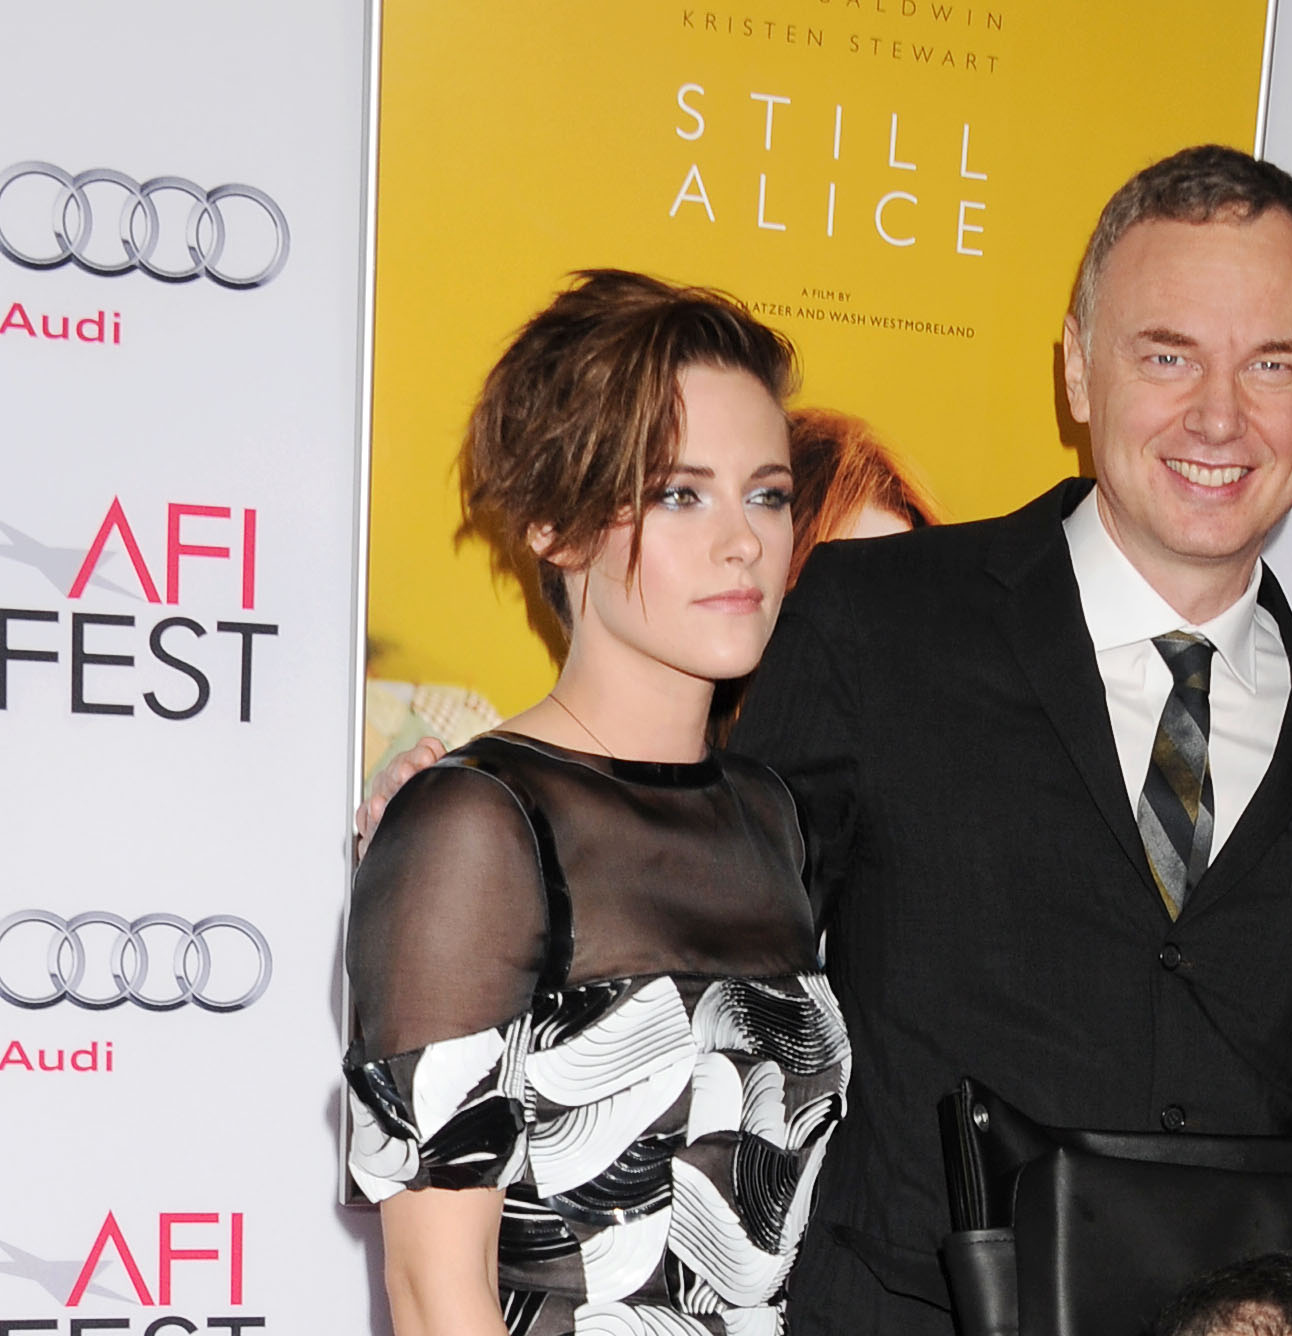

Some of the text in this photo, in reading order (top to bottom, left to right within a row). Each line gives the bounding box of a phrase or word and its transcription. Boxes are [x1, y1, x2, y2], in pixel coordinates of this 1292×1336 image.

[683, 10, 999, 73] KRISTEN STEWART
[819, 0, 1003, 31] LDWIN
[676, 83, 987, 180] STILL
[669, 165, 986, 256] ALICE
[0, 304, 120, 344] Audi
[797, 308, 825, 320] AND
[829, 311, 866, 325] WASH
[870, 316, 975, 338] WESTMORELAND
[801, 288, 850, 302] A FILM BY
[68, 496, 256, 610] AFI
[0, 608, 278, 722] FEST
[0, 1041, 112, 1072] Audi
[66, 1212, 243, 1307] AFI
